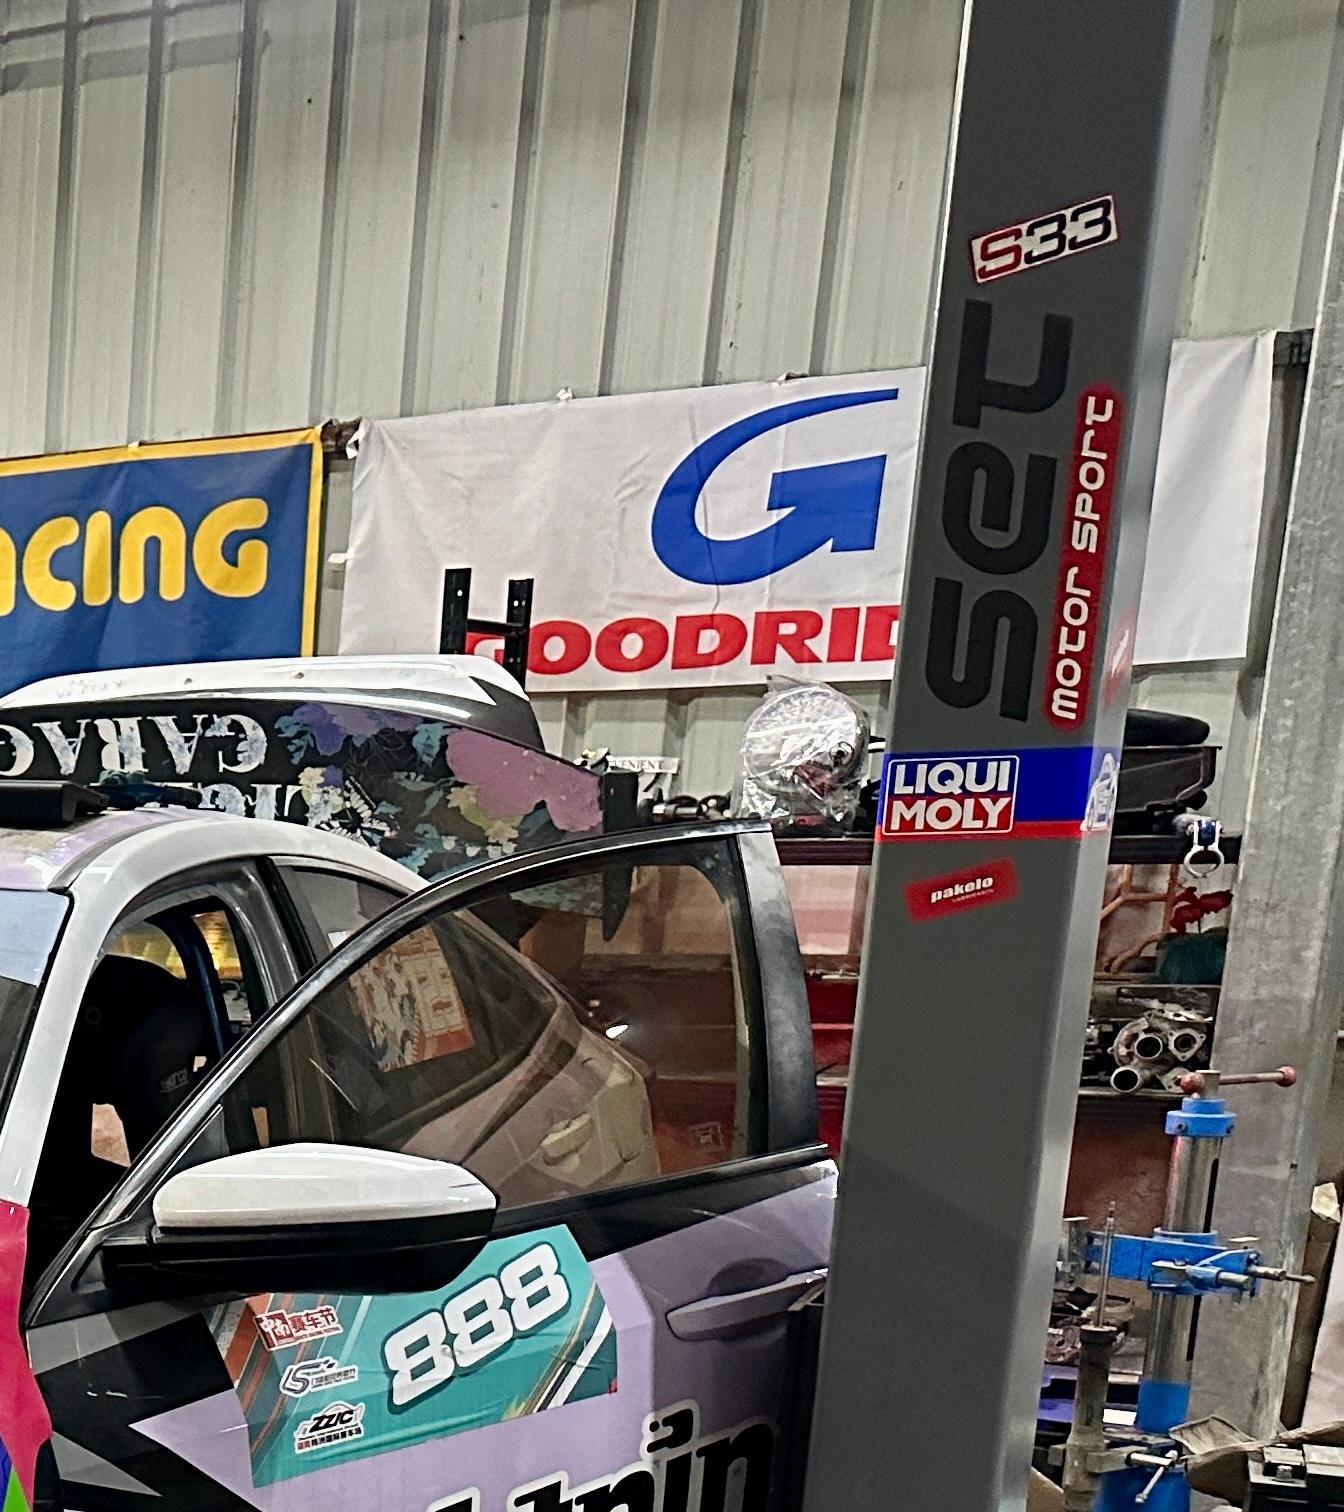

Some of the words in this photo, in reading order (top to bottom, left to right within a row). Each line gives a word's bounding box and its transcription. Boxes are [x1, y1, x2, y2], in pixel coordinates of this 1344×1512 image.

[978, 199, 1112, 280] S33
[893, 760, 1011, 797] LIQUI
[889, 796, 1013, 833] MOLY
[930, 876, 994, 904] pakelo
[384, 1241, 571, 1407] 888
